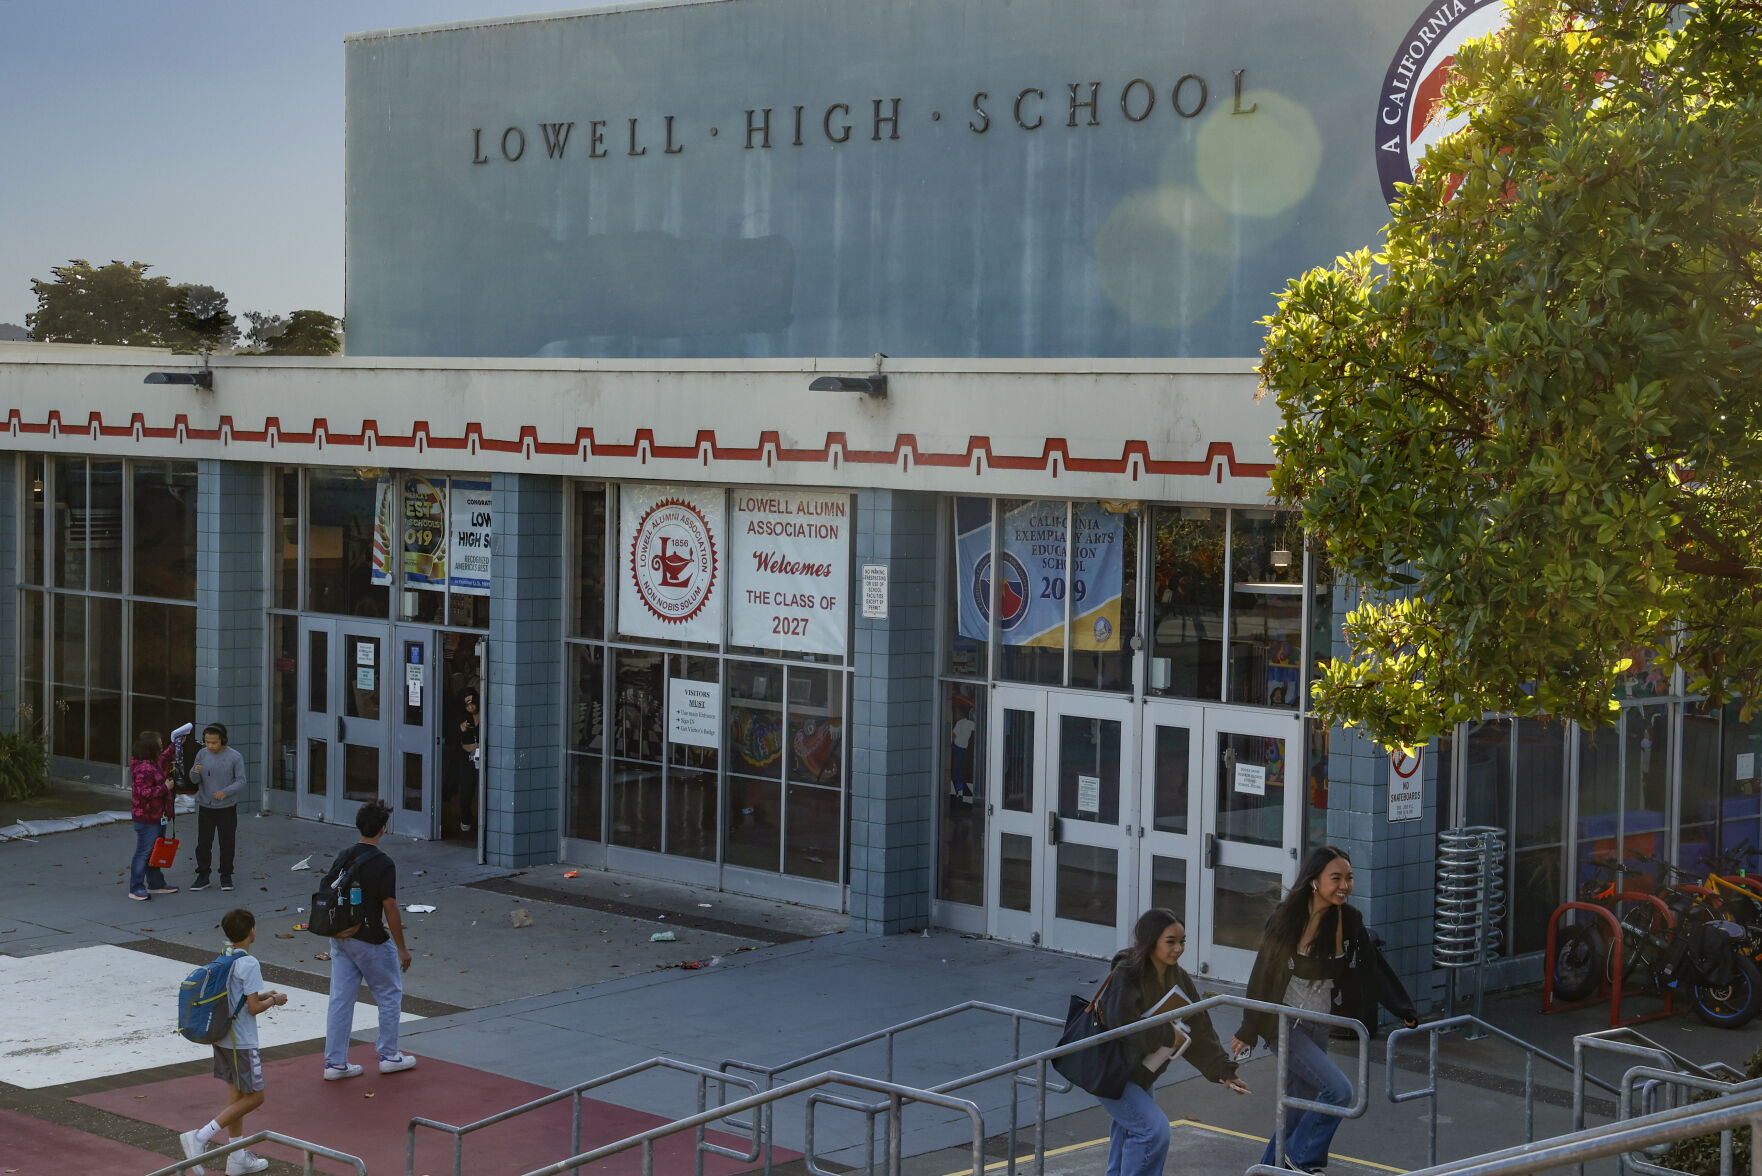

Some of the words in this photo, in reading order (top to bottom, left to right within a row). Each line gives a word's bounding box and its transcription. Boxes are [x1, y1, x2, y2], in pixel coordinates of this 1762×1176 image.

[1382, 0, 1467, 125] CALIFORNIA
[472, 115, 683, 164] LOWELL
[744, 98, 901, 149] HIGH
[969, 68, 1257, 134] SCHOOL
[1381, 134, 1400, 153] A
[738, 497, 793, 515] LOWELL
[409, 519, 441, 528] SCHOOLS
[747, 520, 838, 540] ASSOCIATION
[458, 531, 482, 548] HIGH
[639, 529, 656, 568] LOWELL
[652, 512, 680, 530] ALUMNI
[680, 515, 708, 573] ASSOCIATION
[672, 539, 688, 548] 1856
[1015, 530, 1083, 544] EXEMPLAY
[1085, 532, 1115, 544] ARTS
[1031, 544, 1097, 559] EDUCAION
[753, 550, 832, 578] Welcomes
[643, 580, 657, 602] NON
[657, 597, 679, 611] NOBIS
[681, 586, 702, 610] SOLUM
[1040, 577, 1086, 601] 209
[746, 590, 770, 605] THE
[774, 592, 815, 609] CLASS
[820, 596, 837, 610] OF
[772, 616, 809, 637] 2027
[685, 689, 710, 698] VISITORS
[689, 700, 705, 708] MUST
[1403, 782, 1409, 790] NO
[1391, 792, 1420, 802] SKATEBOARDS
